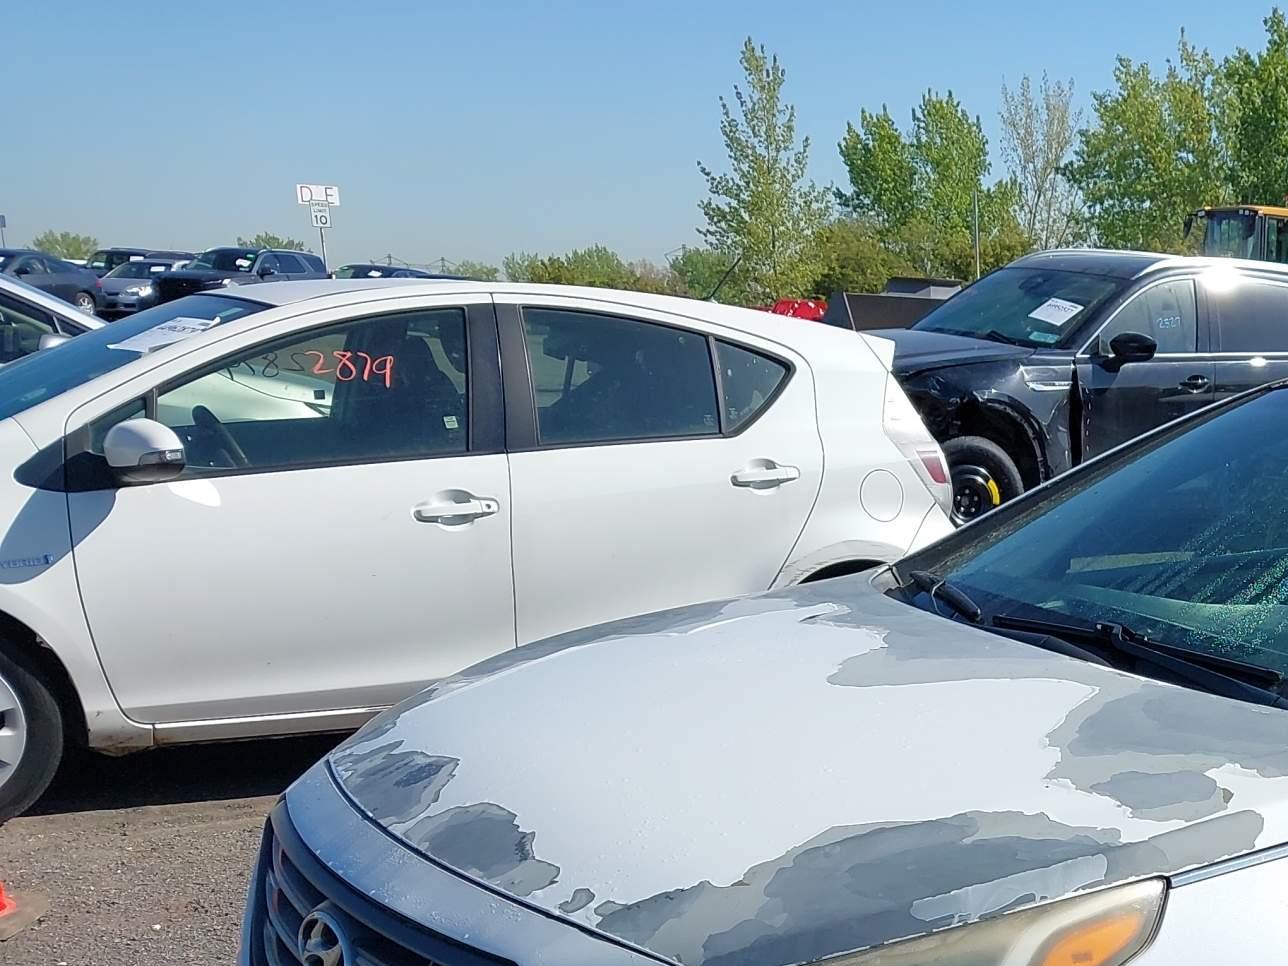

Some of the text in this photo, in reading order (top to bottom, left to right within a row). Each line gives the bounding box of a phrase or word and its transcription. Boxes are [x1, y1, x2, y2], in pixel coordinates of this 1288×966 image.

[300, 185, 313, 202] D
[314, 214, 328, 225] 10
[304, 350, 395, 388] 2879
